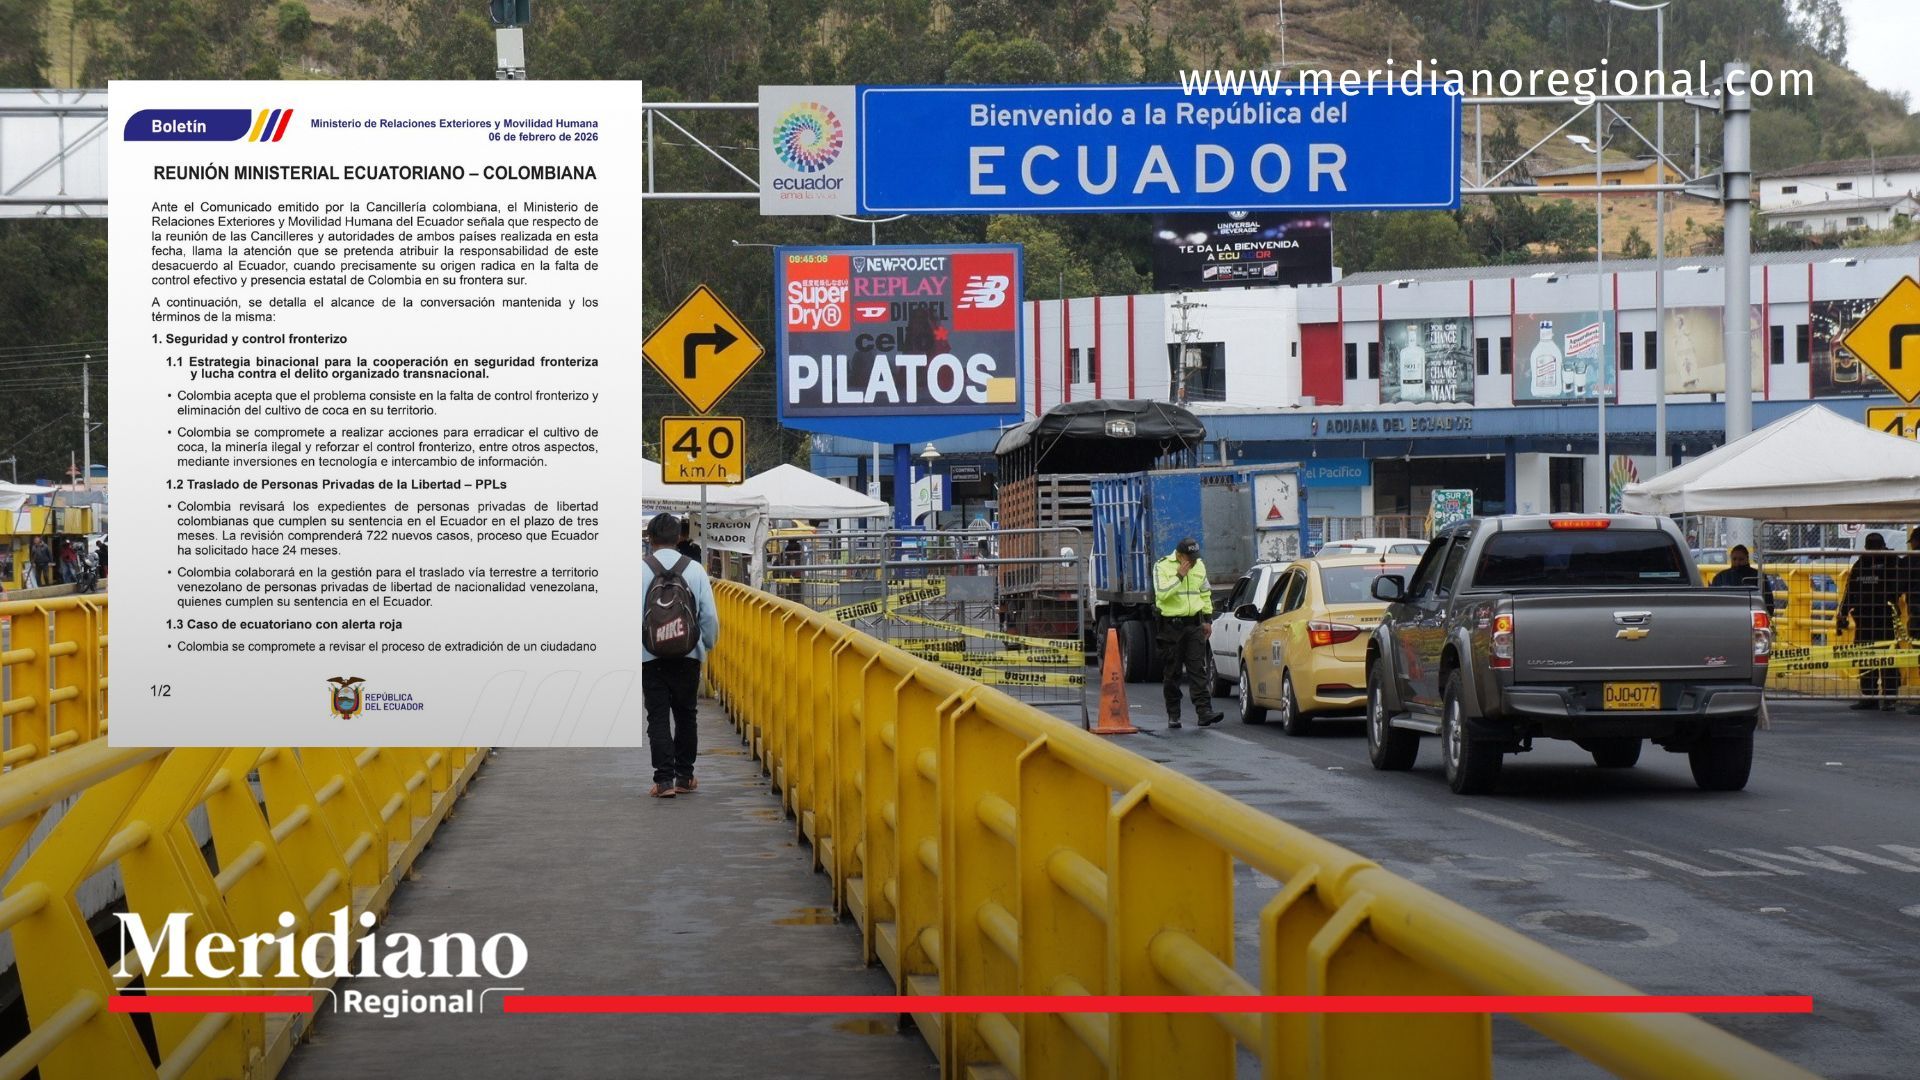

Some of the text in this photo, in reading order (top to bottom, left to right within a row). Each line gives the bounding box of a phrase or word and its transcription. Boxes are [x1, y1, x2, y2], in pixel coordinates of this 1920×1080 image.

[970, 101, 1348, 130] Bienvenido a la República del
[969, 142, 1348, 195] ECUADOR
[773, 174, 844, 190] ecuador
[780, 191, 803, 200] ama
[1217, 222, 1260, 230] UNIVERSAL
[1179, 240, 1300, 254] TE DA LA BIENVENIDA
[866, 257, 945, 272] NEWPROJECT
[1207, 253, 1216, 261] A
[788, 281, 849, 309] Super
[853, 276, 949, 297] REPLAY
[788, 353, 997, 404] PILATOS
[1431, 385, 1457, 401] WANT
[1326, 415, 1473, 434] ADUANA DEL ECUADOR
[1883, 414, 1920, 440] 4
[672, 426, 734, 459] 40
[680, 463, 727, 478] km/h
[1319, 466, 1362, 478] Pacífico
[898, 587, 942, 606] PELIGRO
[836, 601, 878, 621] PELIGRO
[656, 617, 685, 642] NIKE
[924, 639, 967, 653] PELIGRO
[1851, 656, 1896, 668] PELIGRO
